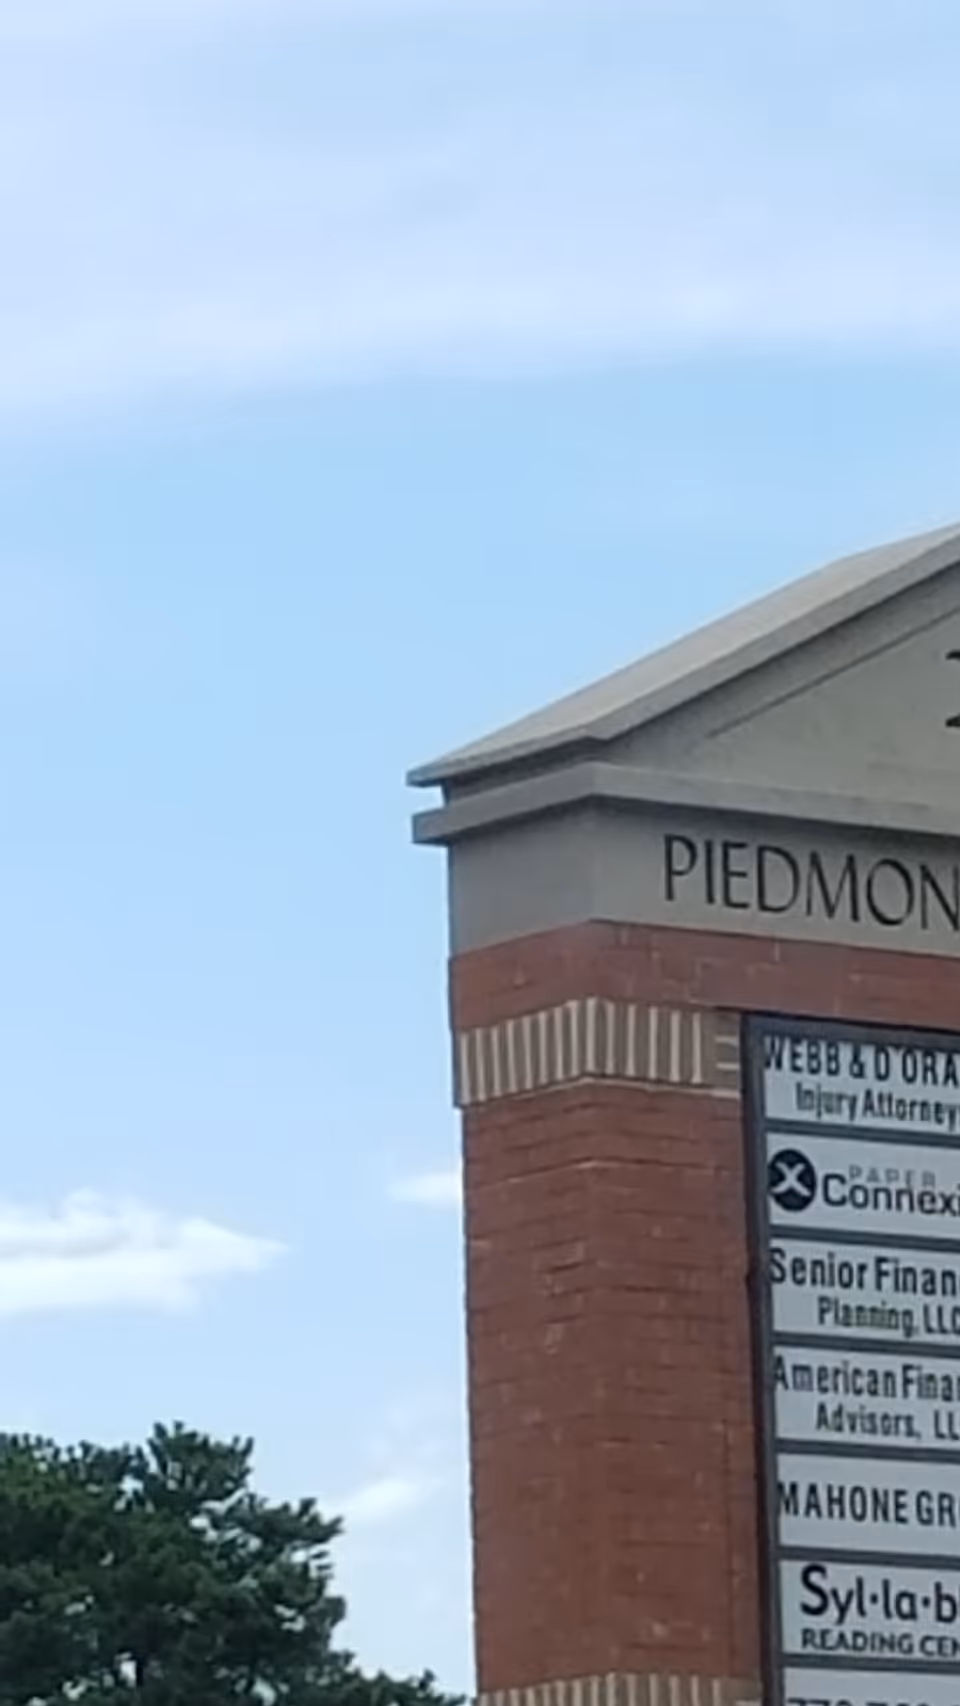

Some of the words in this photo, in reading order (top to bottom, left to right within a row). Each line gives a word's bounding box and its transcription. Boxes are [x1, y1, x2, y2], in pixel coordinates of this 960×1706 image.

[766, 1037, 841, 1077] WEBB
[849, 1044, 865, 1079] &
[796, 1082, 859, 1121] Injury
[849, 1164, 937, 1187] PAPER
[769, 1247, 866, 1290] Senior
[774, 1354, 899, 1399] American
[815, 1401, 922, 1440] Advisors,
[777, 1480, 909, 1525] MAHONE
[801, 1628, 914, 1655] READING
